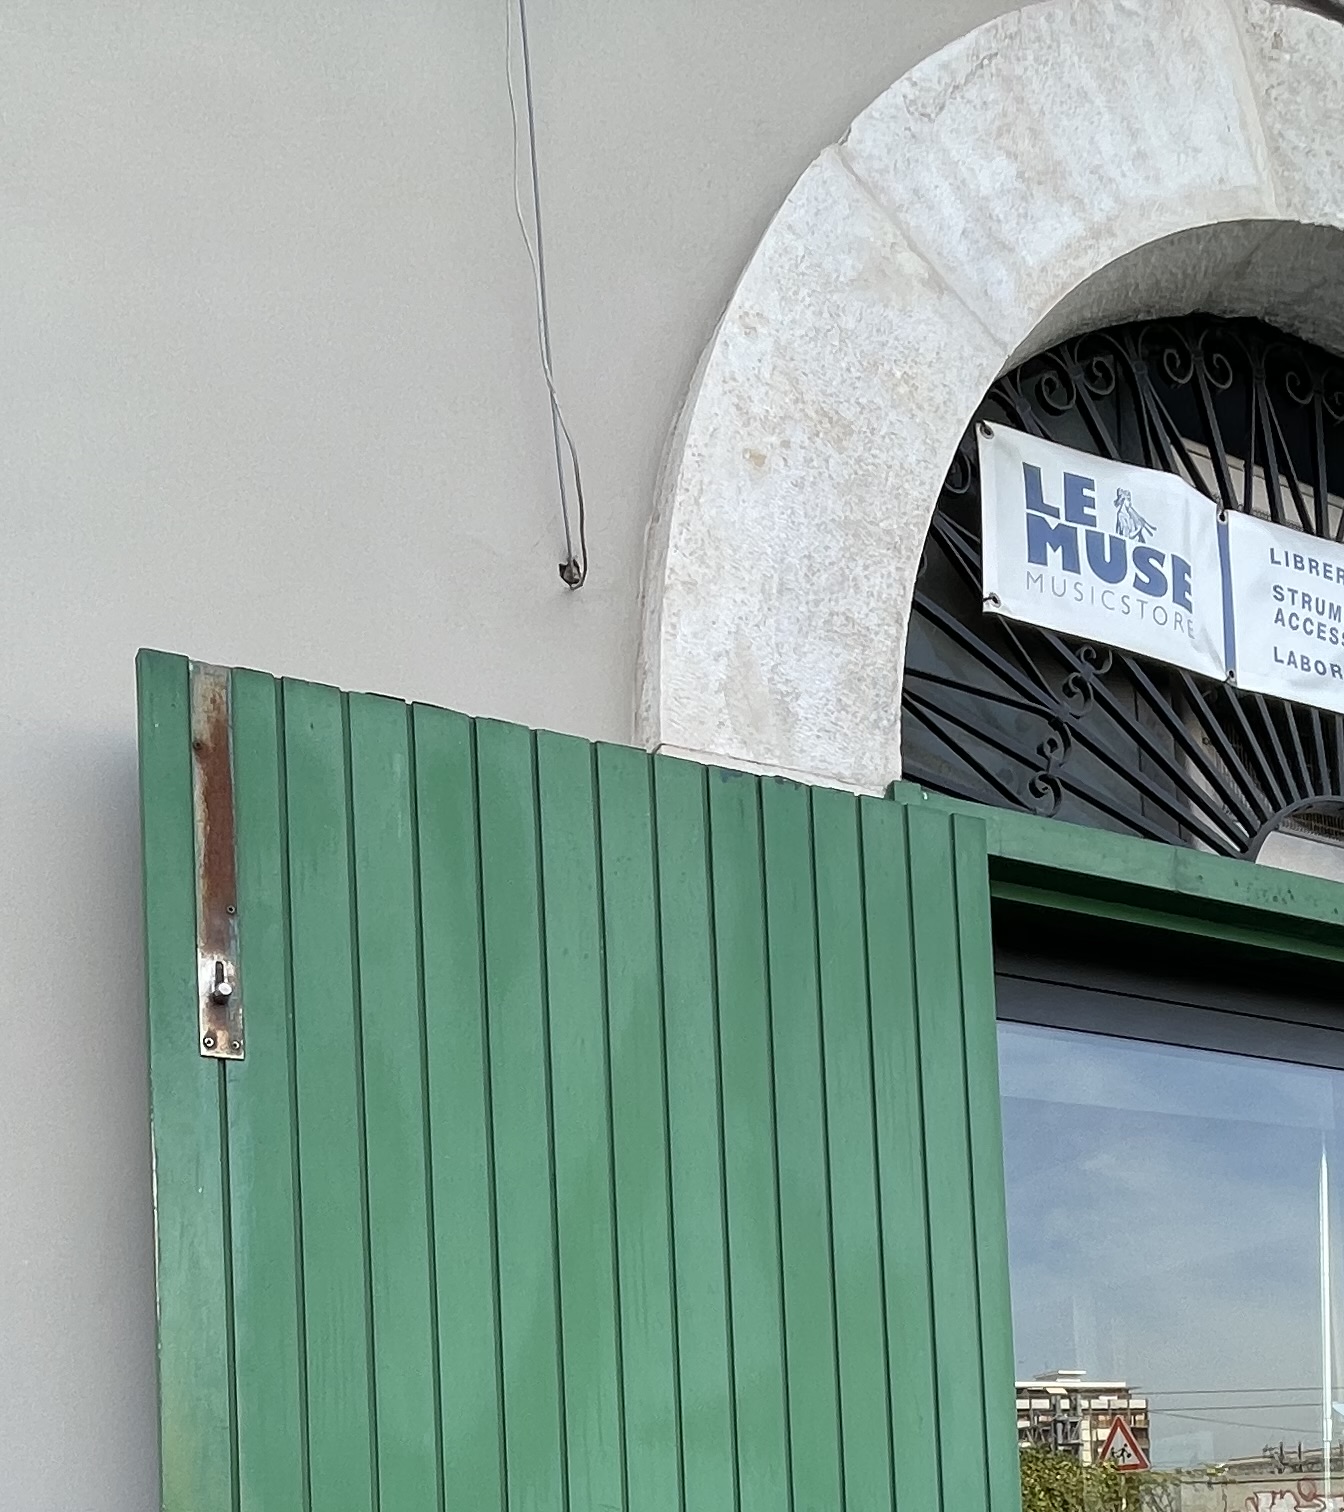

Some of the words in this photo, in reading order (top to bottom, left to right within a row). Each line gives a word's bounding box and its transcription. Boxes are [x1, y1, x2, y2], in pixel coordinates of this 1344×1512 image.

[1022, 461, 1097, 528] LE
[1026, 512, 1193, 614] MUSE
[1026, 570, 1195, 640] MUSICSTORE
